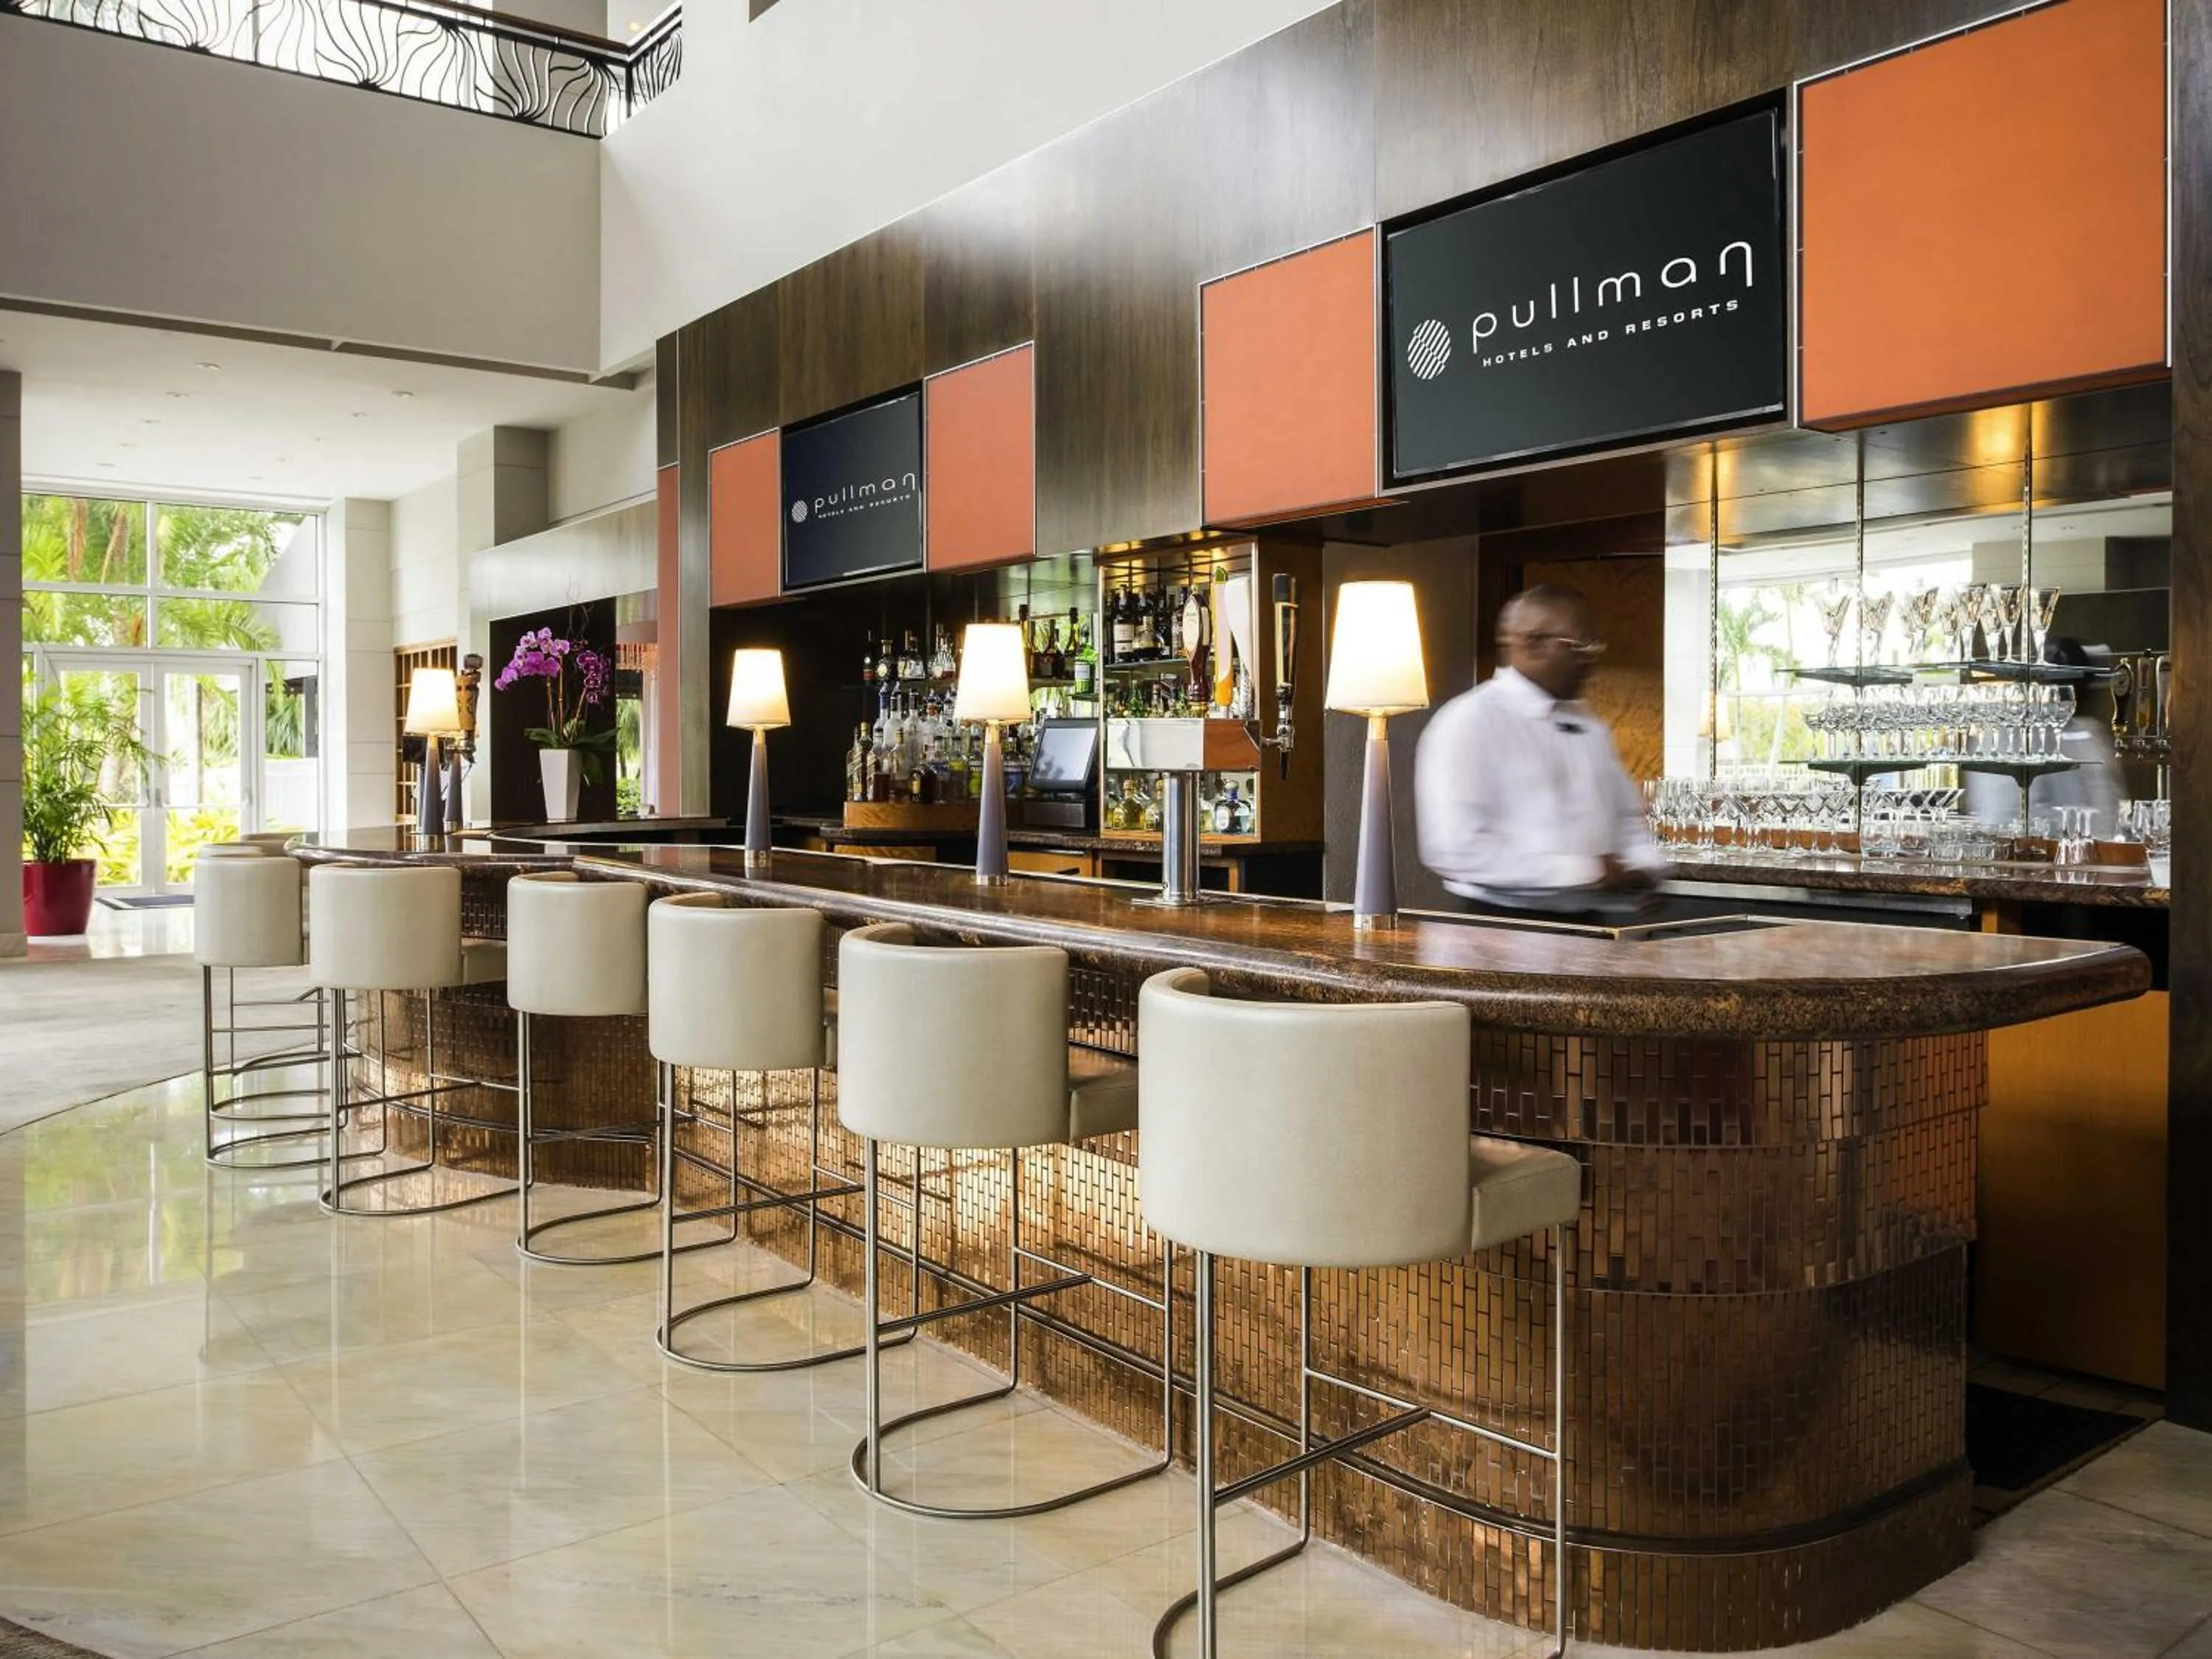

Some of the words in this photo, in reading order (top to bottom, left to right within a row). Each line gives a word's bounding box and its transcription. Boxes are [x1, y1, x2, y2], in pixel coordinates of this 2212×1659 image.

[1472, 240, 1753, 355] pullman
[1483, 343, 1553, 367] HOTELS
[1567, 330, 1609, 349] AND
[1625, 299, 1739, 335] RESORTS
[814, 473, 916, 514] pullman
